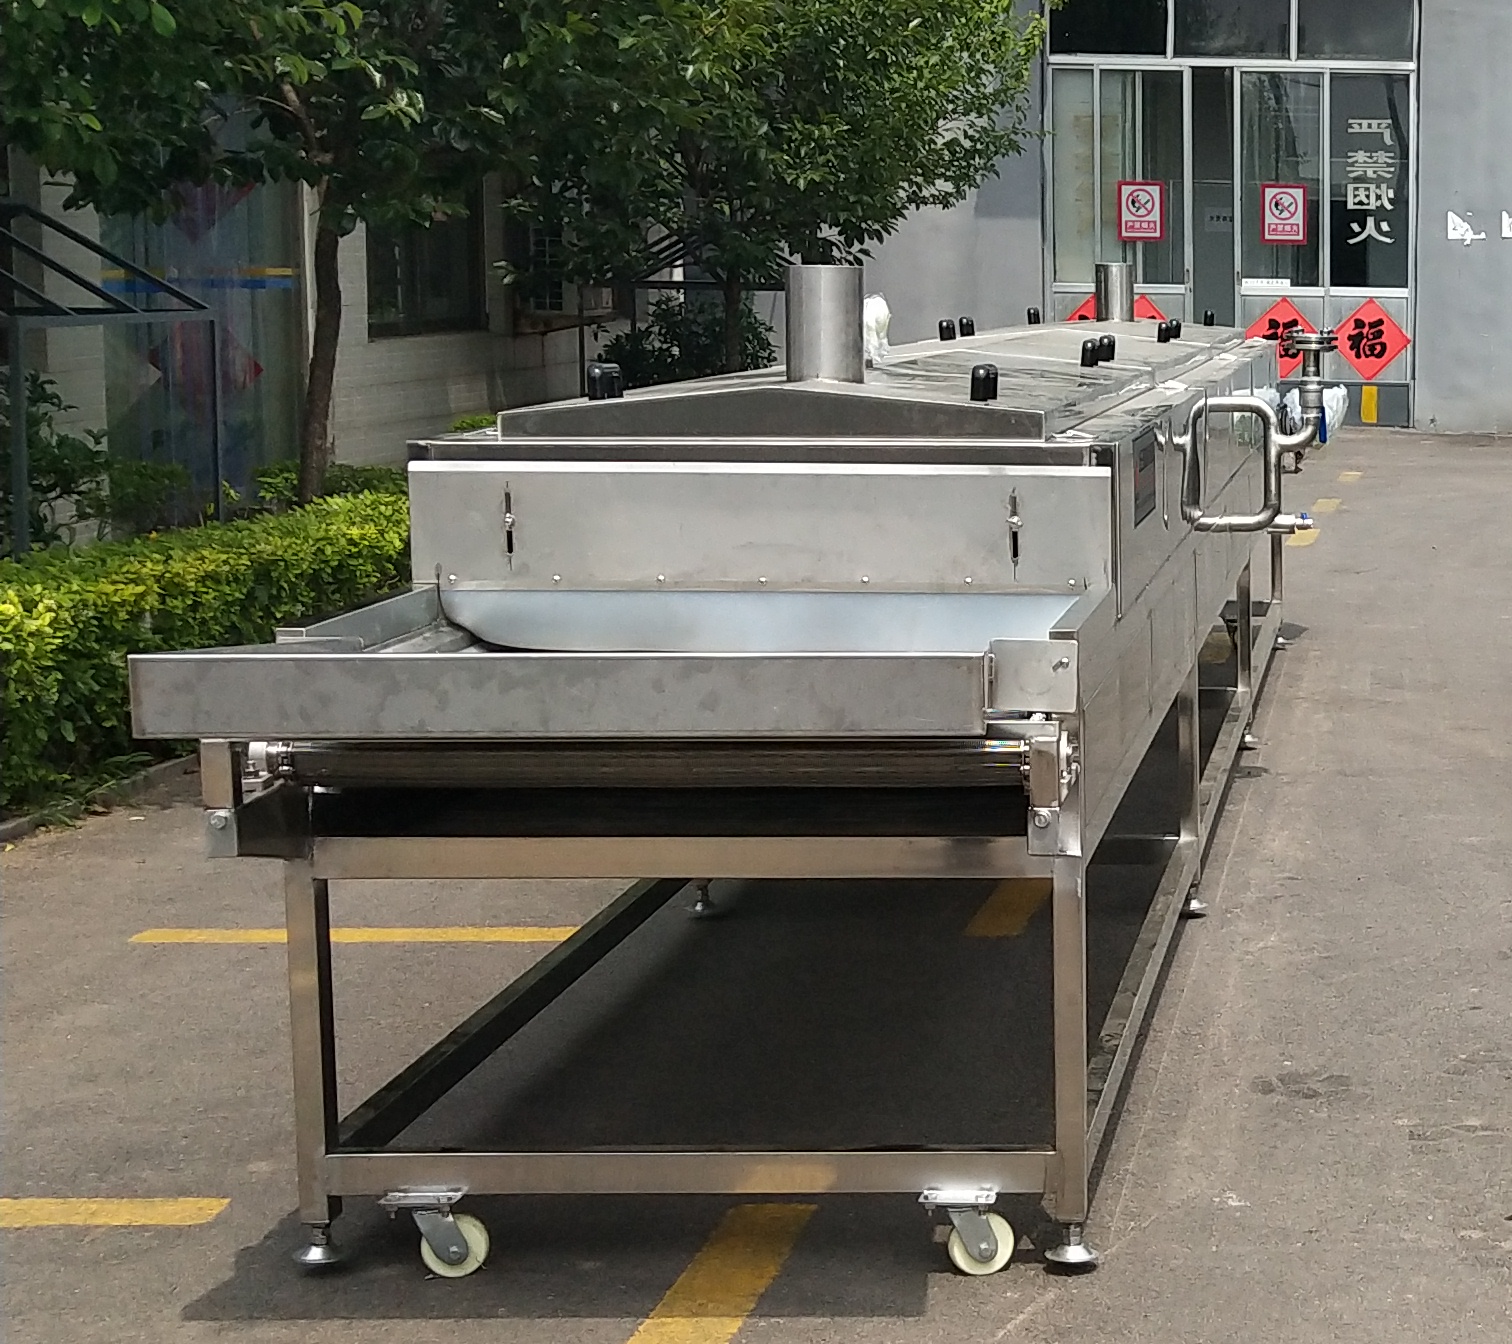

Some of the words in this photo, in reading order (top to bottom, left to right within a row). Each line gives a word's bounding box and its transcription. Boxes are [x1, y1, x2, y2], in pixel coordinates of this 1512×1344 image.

[1126, 220, 1156, 230] 严禁烟火
[1269, 223, 1299, 233] 严禁烟火
[1347, 318, 1387, 359] 福
